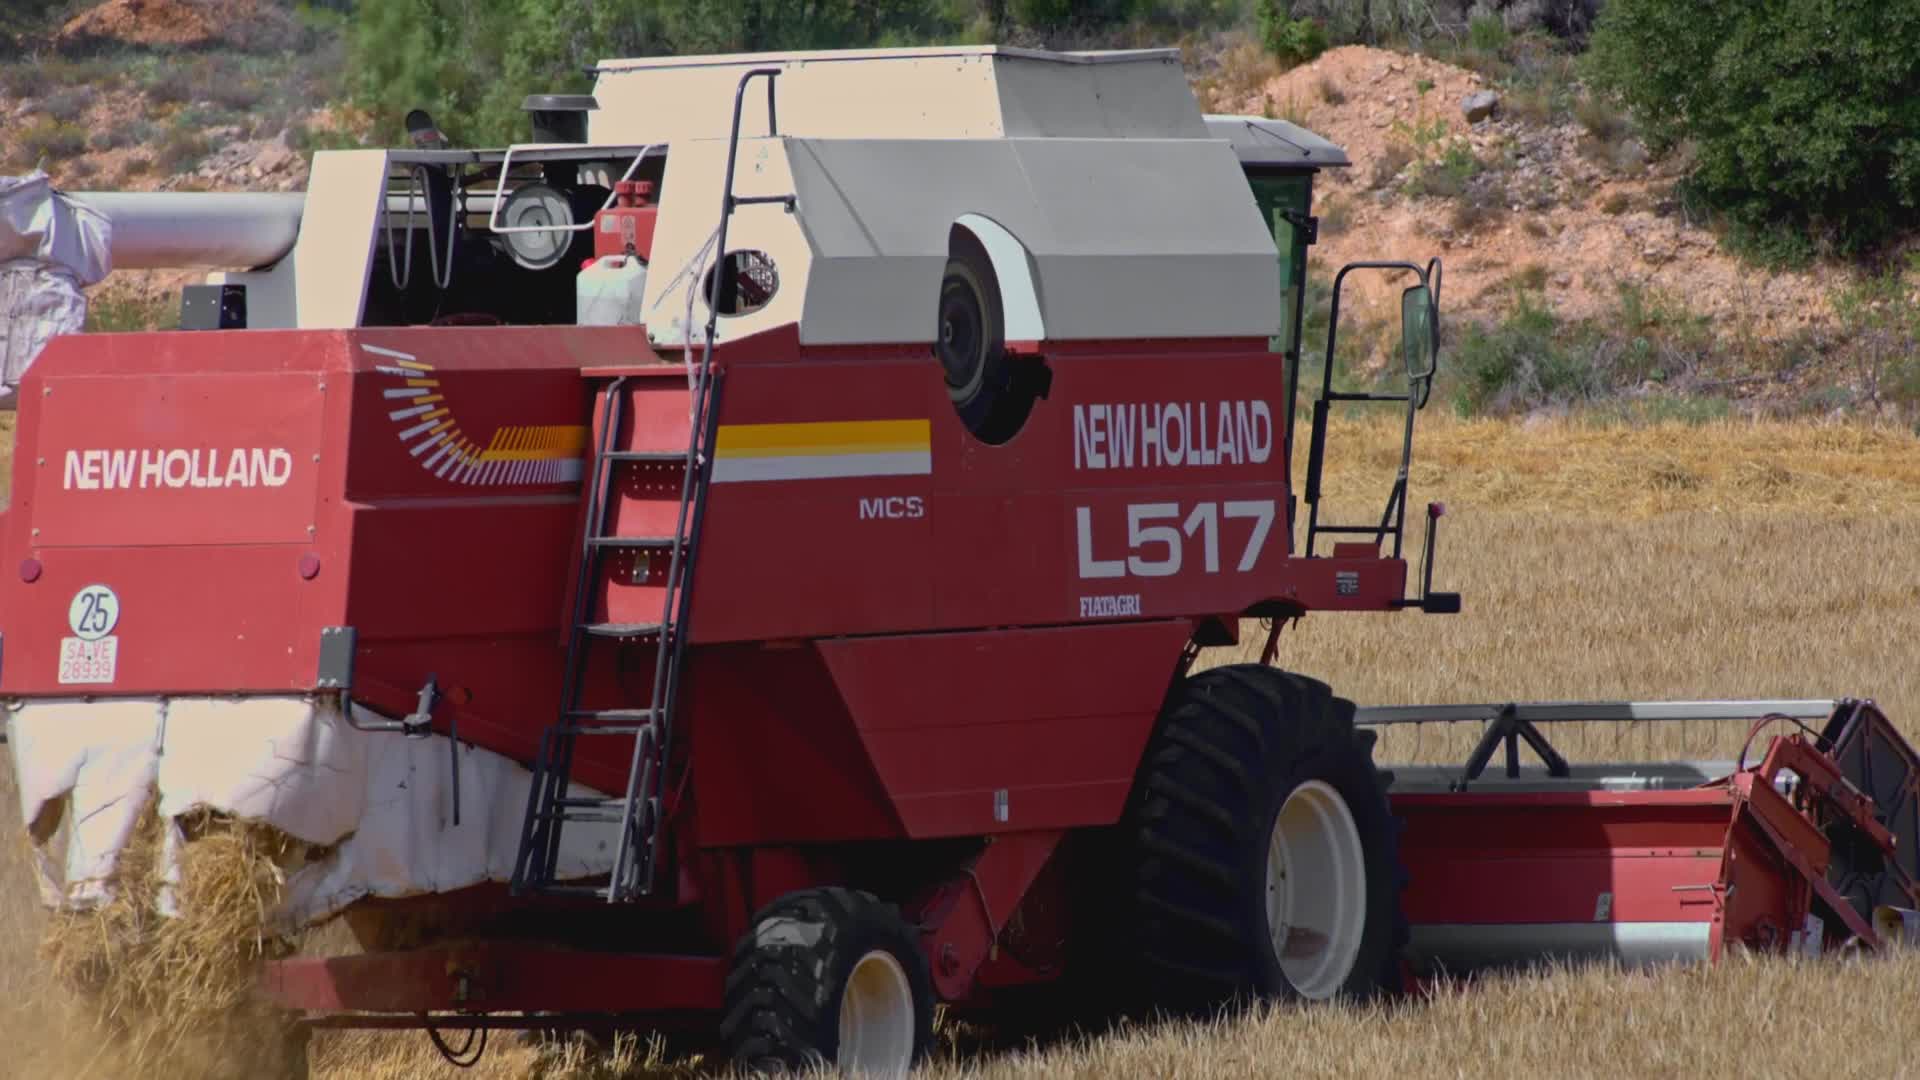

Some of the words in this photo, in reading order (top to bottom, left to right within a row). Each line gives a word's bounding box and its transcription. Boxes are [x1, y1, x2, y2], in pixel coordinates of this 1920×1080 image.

[1073, 403, 1136, 470] NEW
[1141, 400, 1273, 467] HOLLAND
[63, 449, 137, 490] NEW
[139, 448, 292, 488] HOLLAND
[859, 495, 924, 520] MCS
[1076, 499, 1276, 579] L517
[79, 592, 109, 631] 25
[1079, 594, 1142, 618] FIATAGRI
[62, 661, 112, 680] 28939
